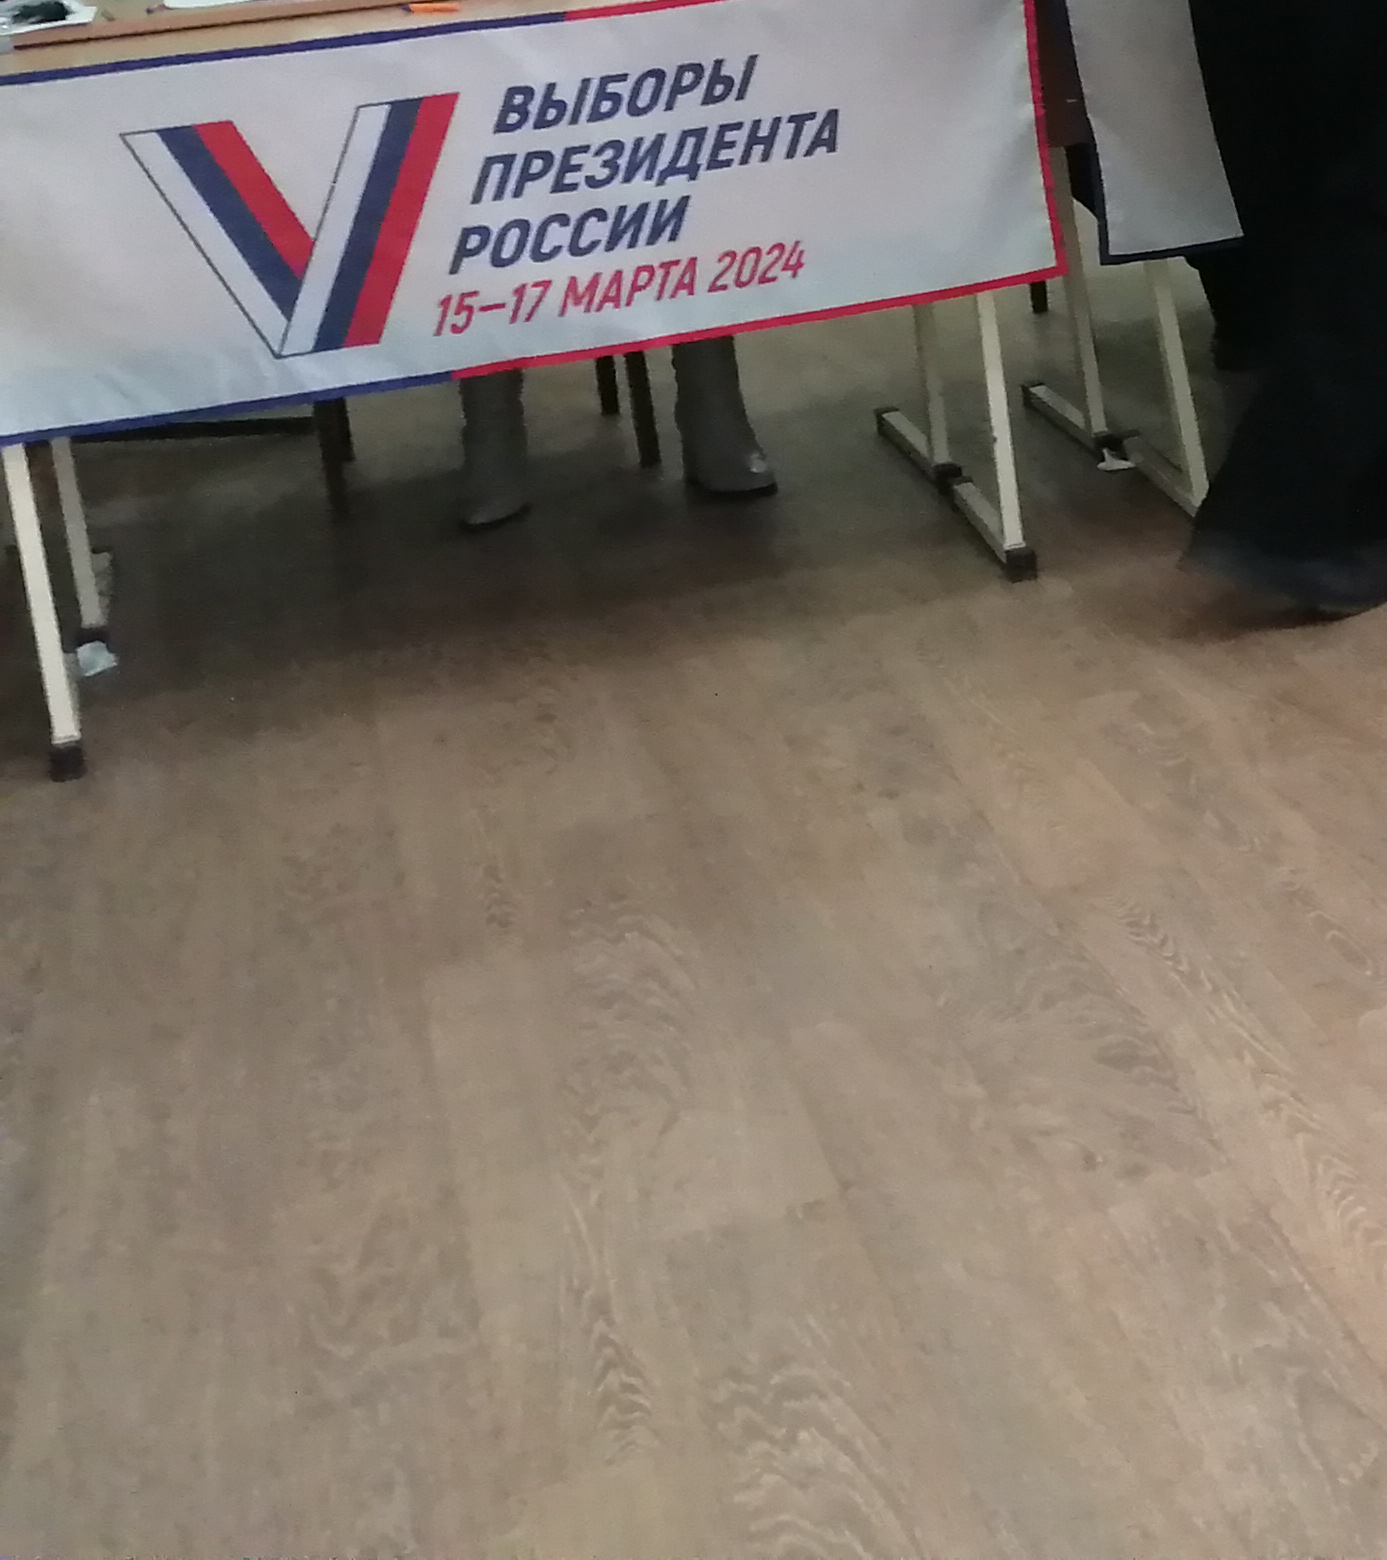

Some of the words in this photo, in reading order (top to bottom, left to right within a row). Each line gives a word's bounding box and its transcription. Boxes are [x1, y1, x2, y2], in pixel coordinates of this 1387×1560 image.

[494, 54, 759, 134] ВЫБОРЫ
[471, 108, 841, 205] ПРЕЗИДЕНТА
[449, 196, 691, 275] РОССИИ
[558, 257, 698, 317] МАРТА
[708, 240, 805, 294] 2024
